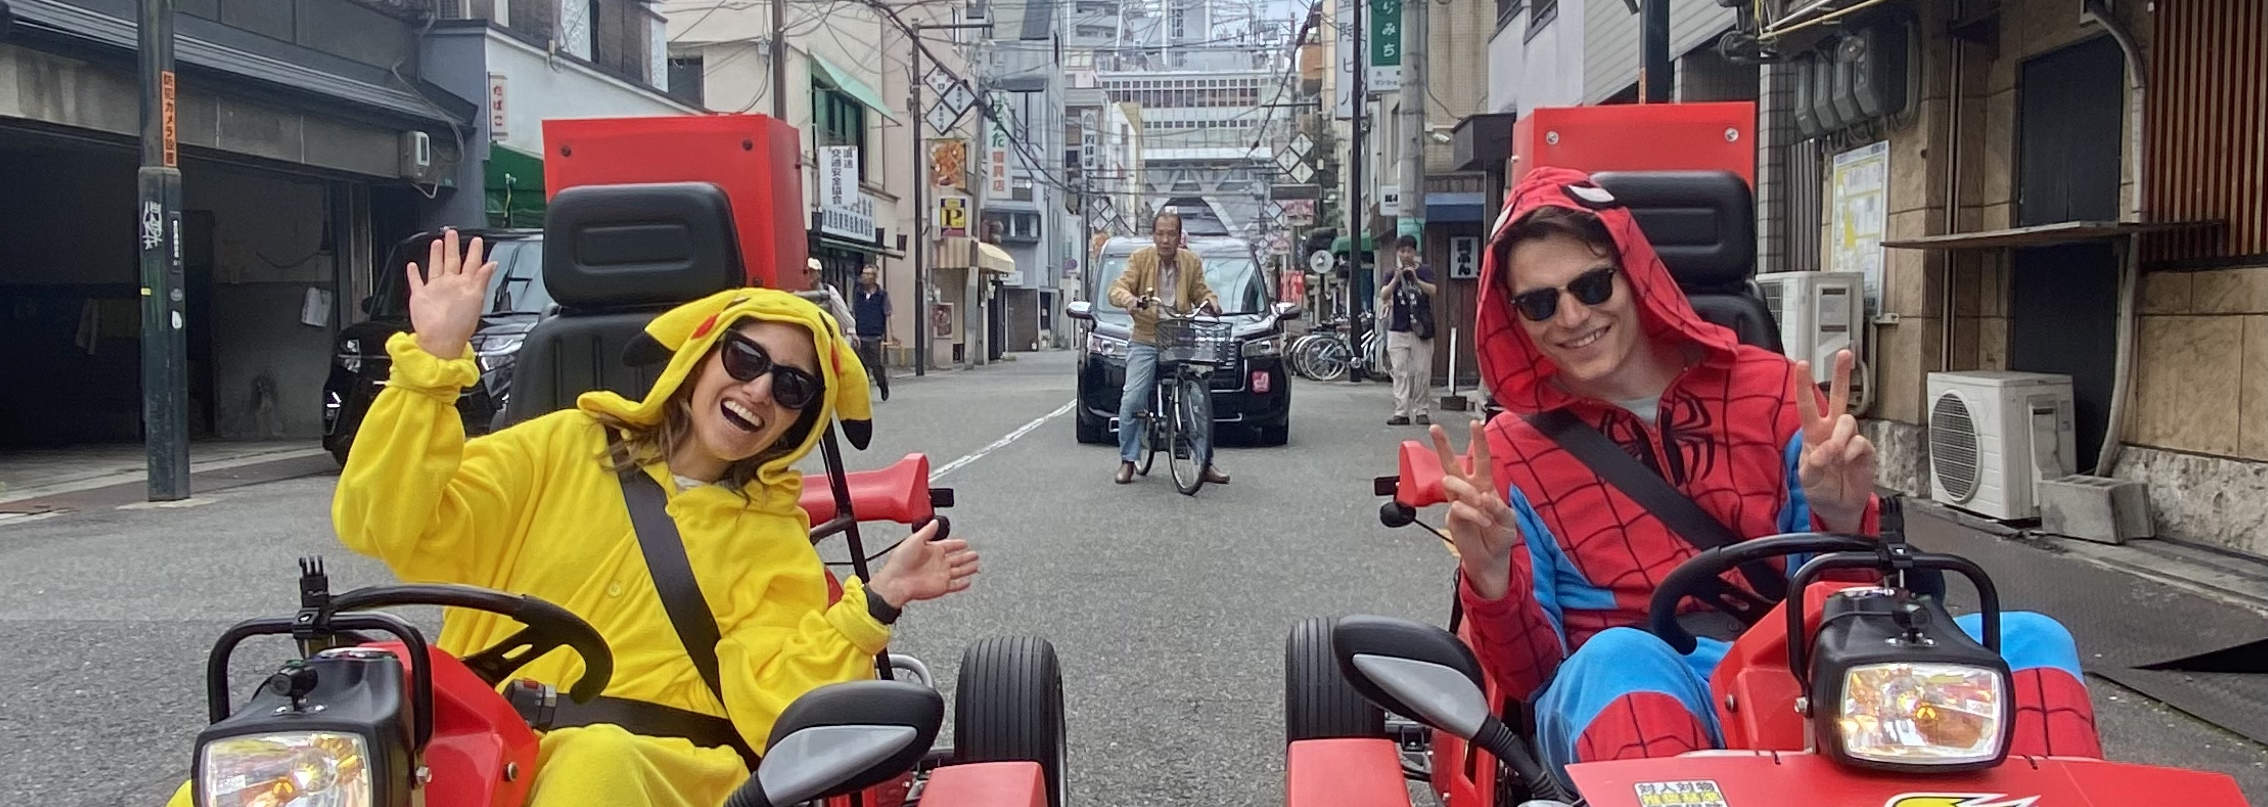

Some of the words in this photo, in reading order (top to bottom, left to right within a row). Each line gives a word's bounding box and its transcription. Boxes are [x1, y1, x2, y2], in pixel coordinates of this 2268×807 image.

[493, 86, 503, 127] たばこ
[831, 148, 842, 205] 交通安全協会
[945, 209, 963, 226] P
[1638, 782, 1715, 793] 対人対物
